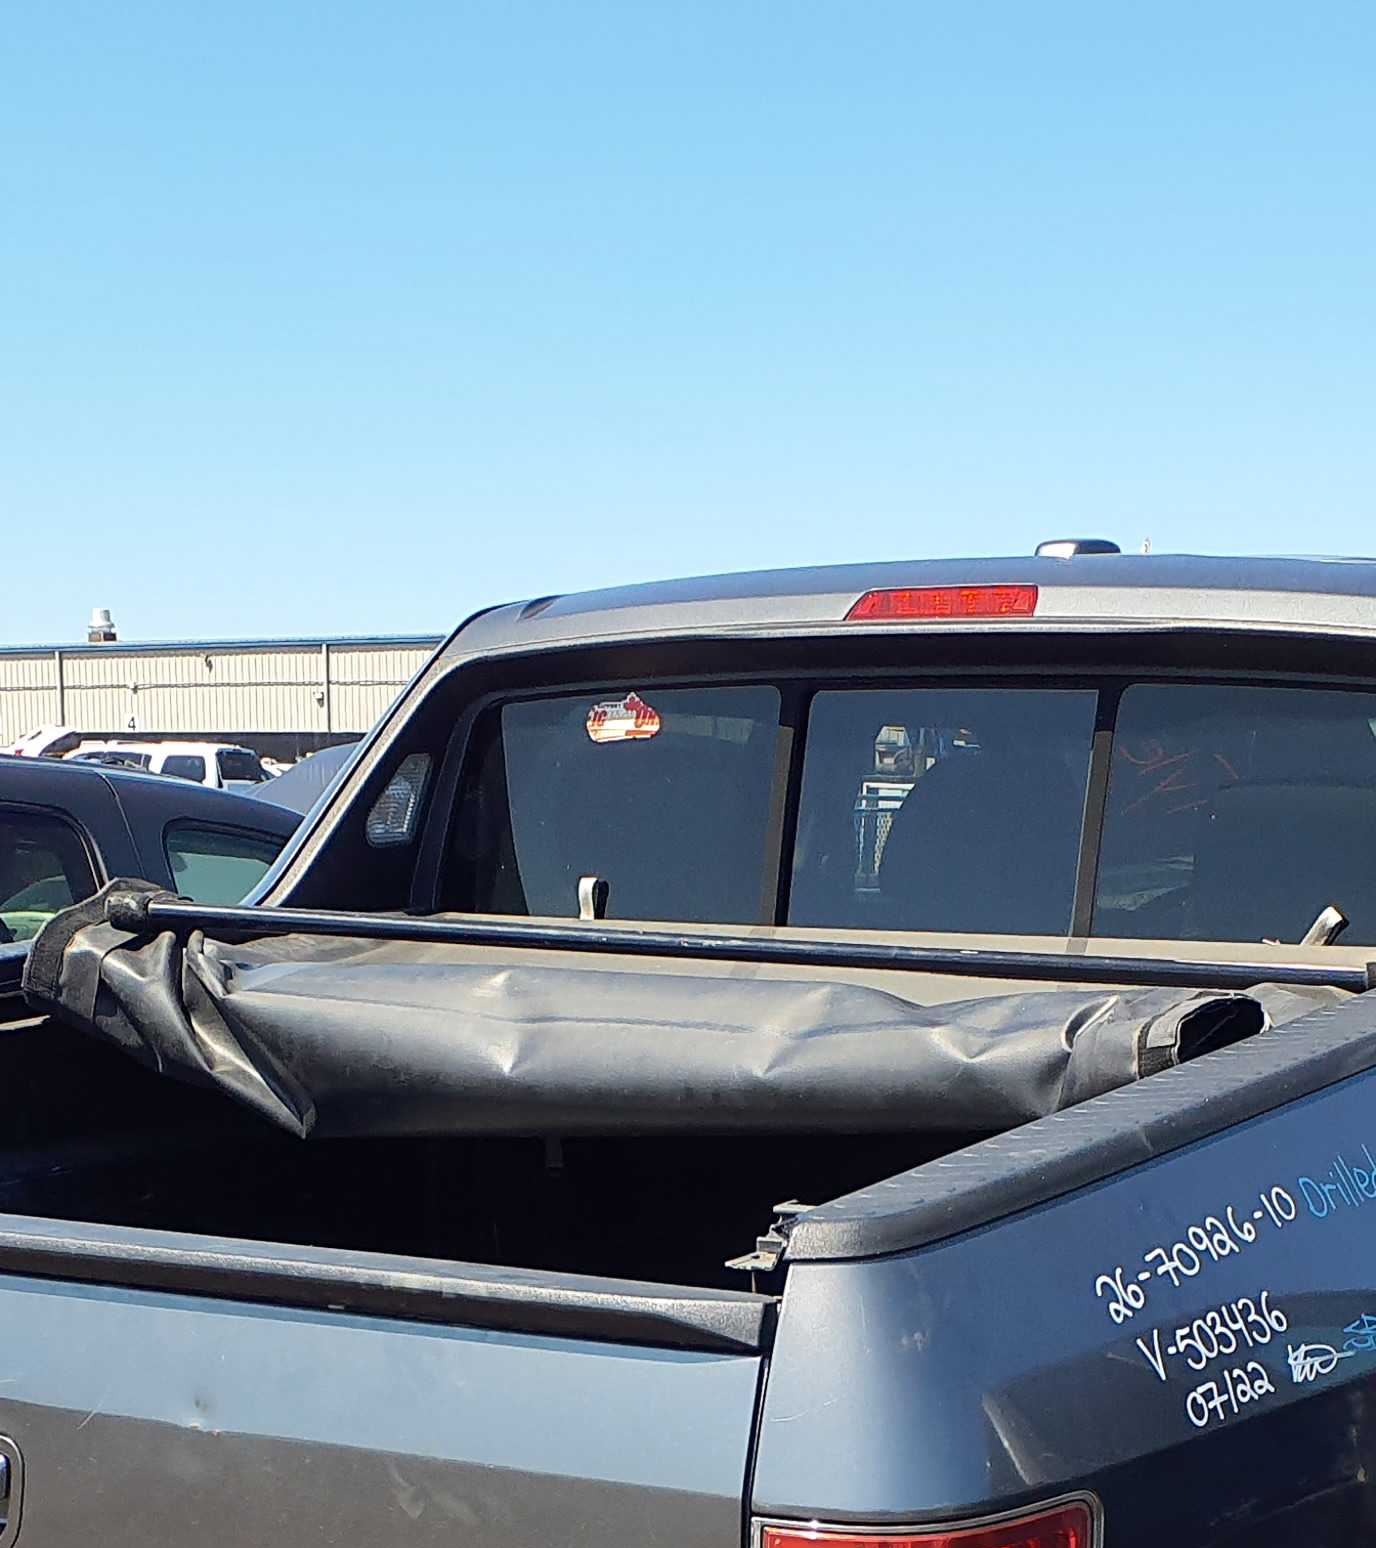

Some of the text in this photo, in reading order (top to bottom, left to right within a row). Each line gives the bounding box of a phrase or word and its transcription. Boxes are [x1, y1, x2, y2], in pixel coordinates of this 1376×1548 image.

[127, 716, 136, 731] 4
[1094, 1186, 1297, 1325] 26-70926-10
[1136, 1290, 1288, 1381] V-503436
[1186, 1361, 1275, 1427] 07/22
